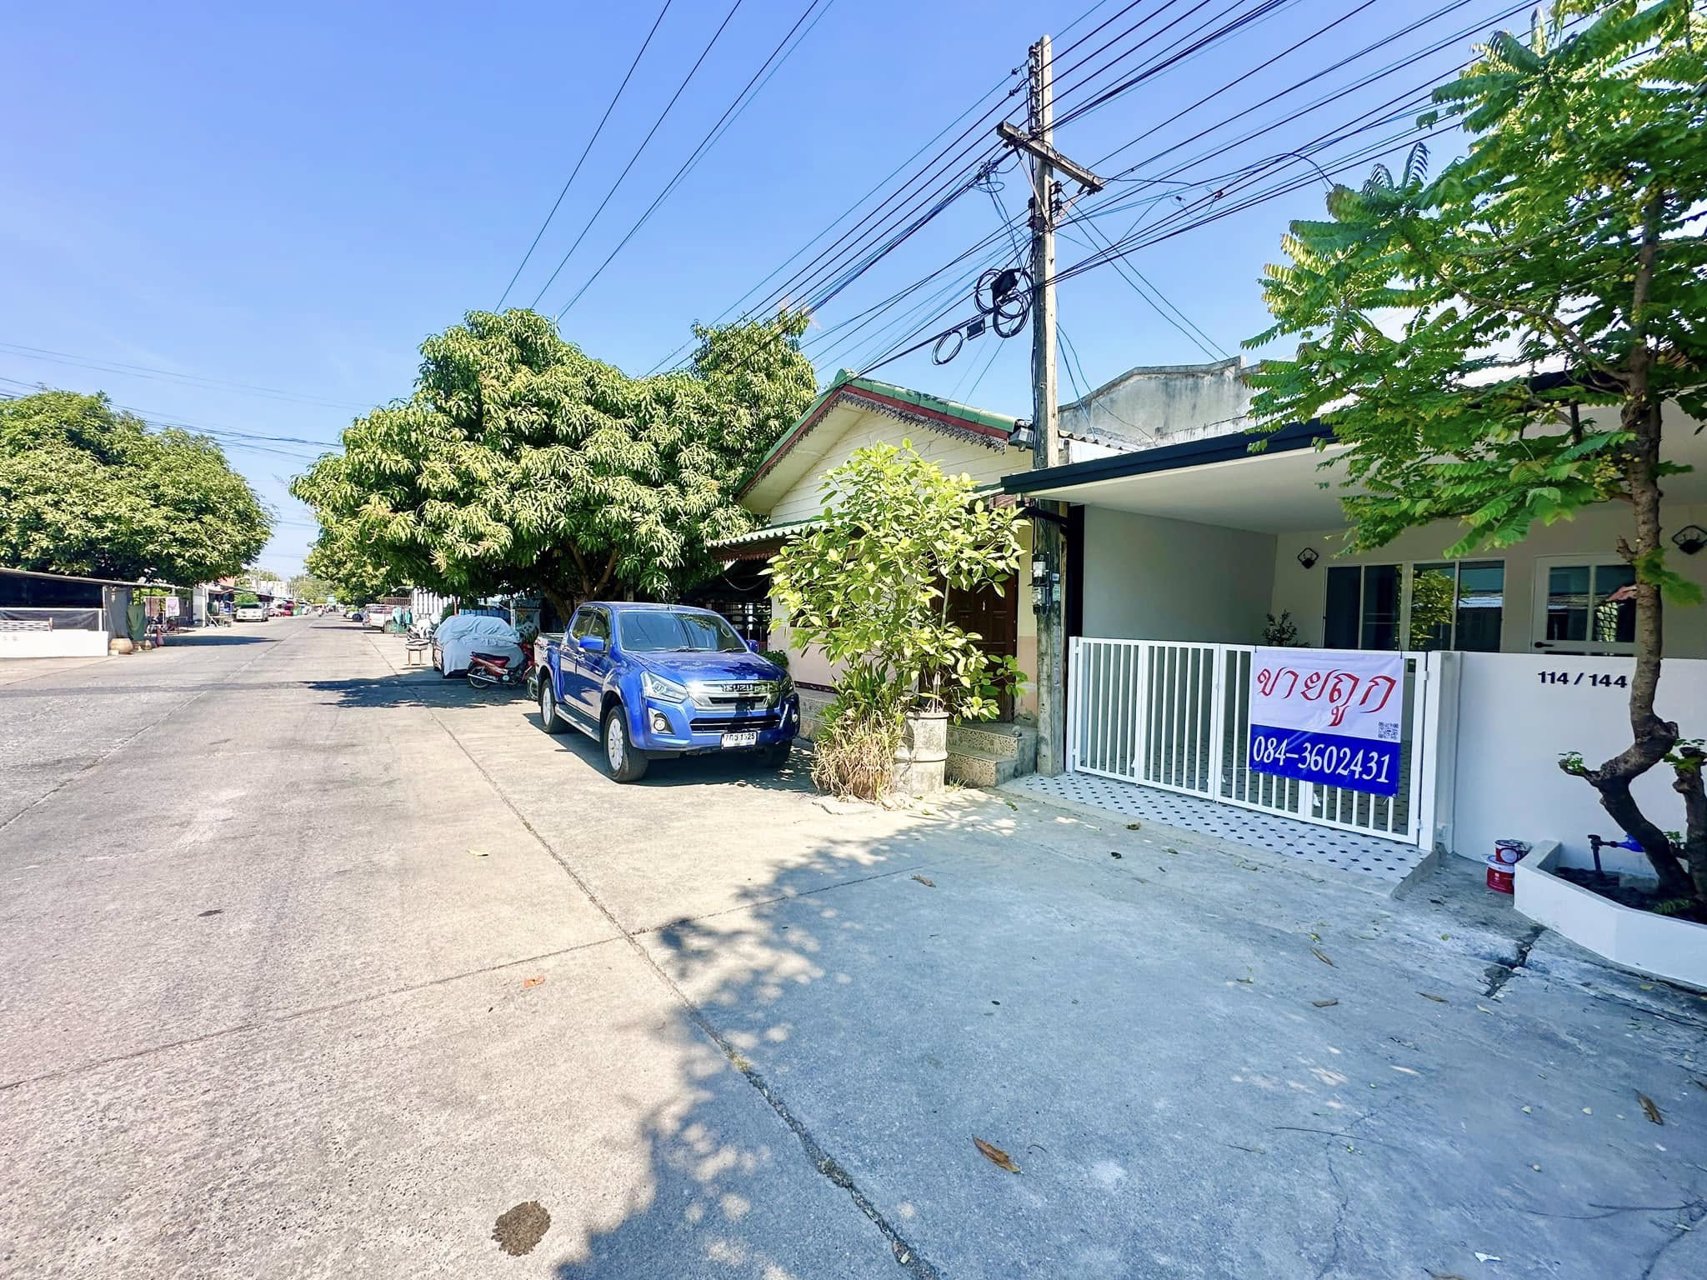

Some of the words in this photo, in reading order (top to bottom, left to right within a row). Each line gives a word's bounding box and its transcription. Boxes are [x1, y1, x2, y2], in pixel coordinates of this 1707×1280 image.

[722, 684, 753, 692] ISUZU
[1256, 666, 1397, 727] ขายถูก
[1252, 735, 1391, 784] 084-3602431
